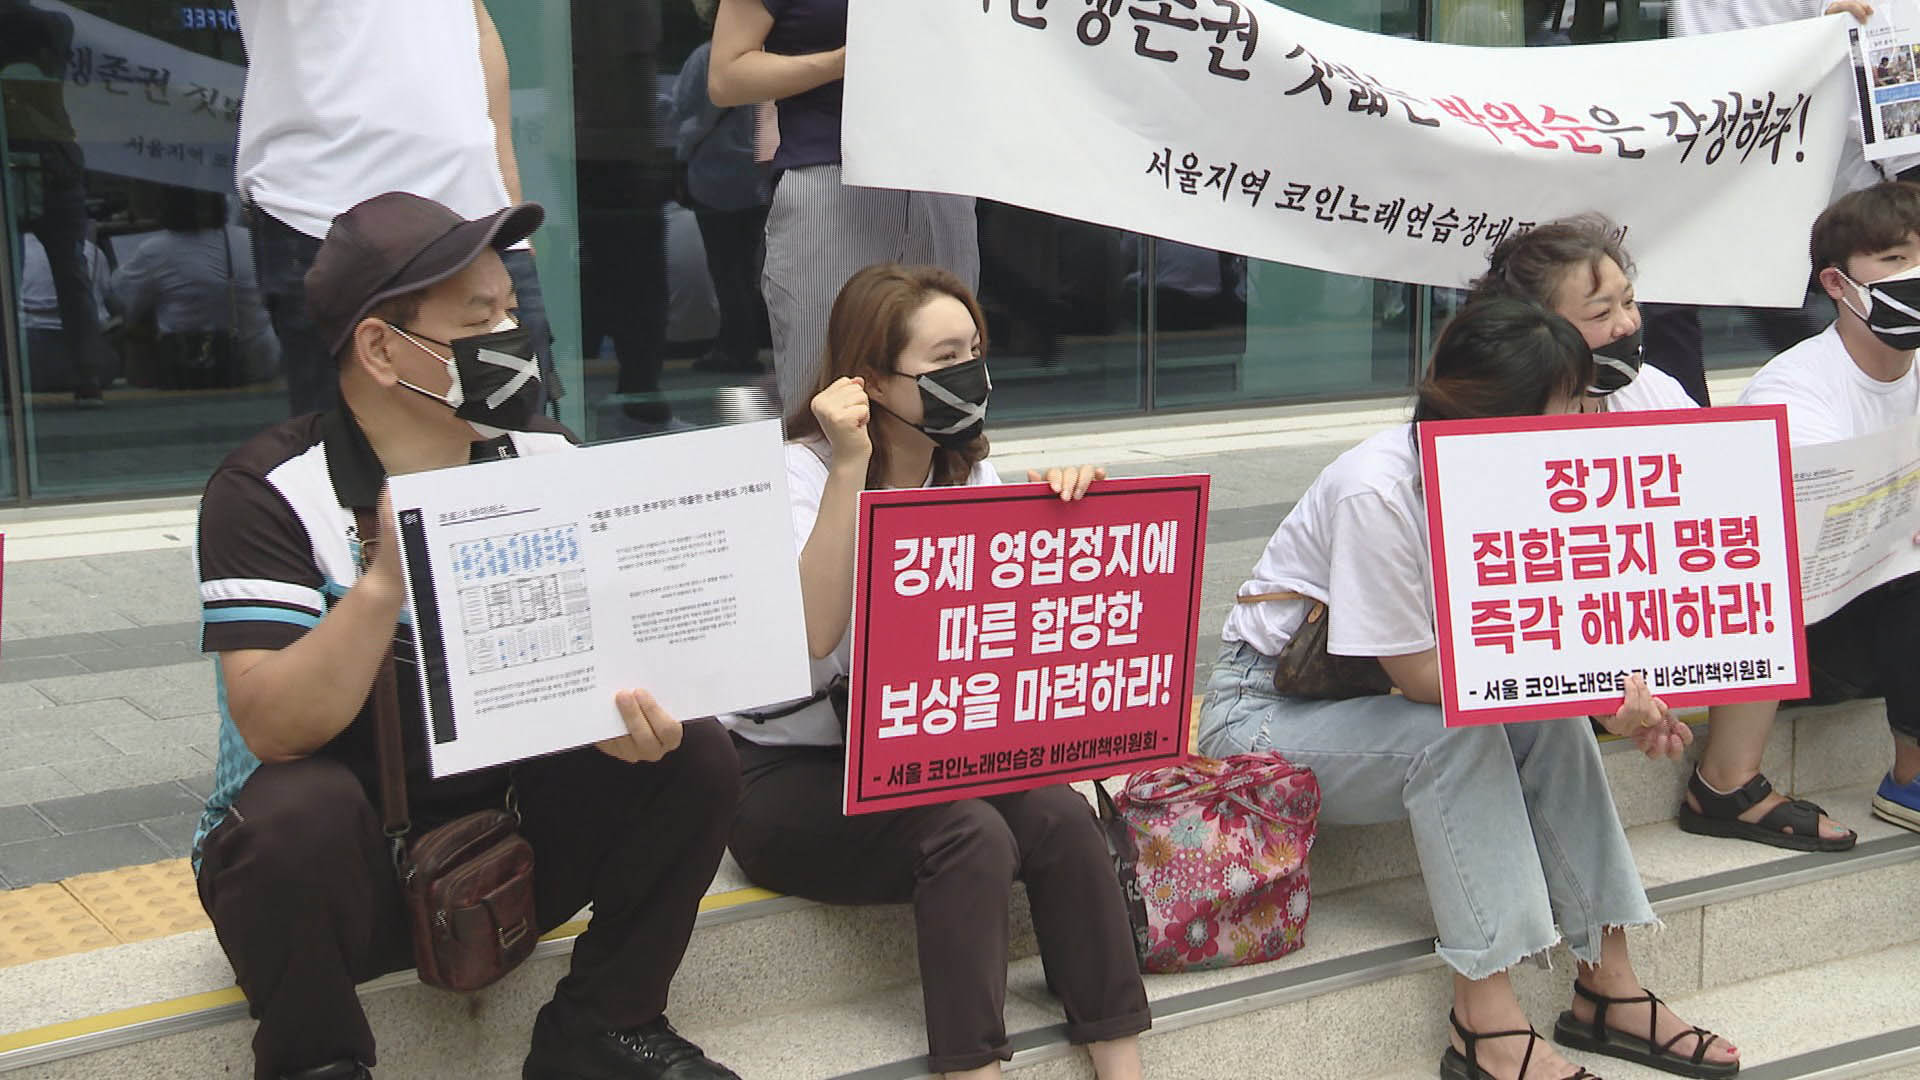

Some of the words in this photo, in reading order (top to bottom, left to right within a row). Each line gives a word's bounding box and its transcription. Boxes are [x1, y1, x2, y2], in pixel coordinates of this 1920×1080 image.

[1649, 91, 1813, 165] 각성하라!
[1145, 147, 1271, 207] 서울지역
[1544, 453, 1682, 513] 장기간
[893, 534, 975, 597] 강제
[989, 520, 1178, 588] 영업정지에
[1472, 521, 1658, 586] 집합금지
[1673, 515, 1761, 573] 명령
[938, 601, 1017, 661] 따른
[1030, 590, 1143, 655] 합당한
[1470, 596, 1563, 654] 즉각
[1577, 582, 1775, 646] 해제하라!
[878, 672, 1001, 739] 보상을
[1013, 654, 1174, 723] 마련하라!
[1483, 679, 1519, 701] 서울
[1654, 658, 1772, 687] 비상대책위원회
[887, 761, 922, 787] 서울
[927, 746, 1046, 780] 코인노래연습장
[1051, 730, 1158, 764] 비상대책위원회
